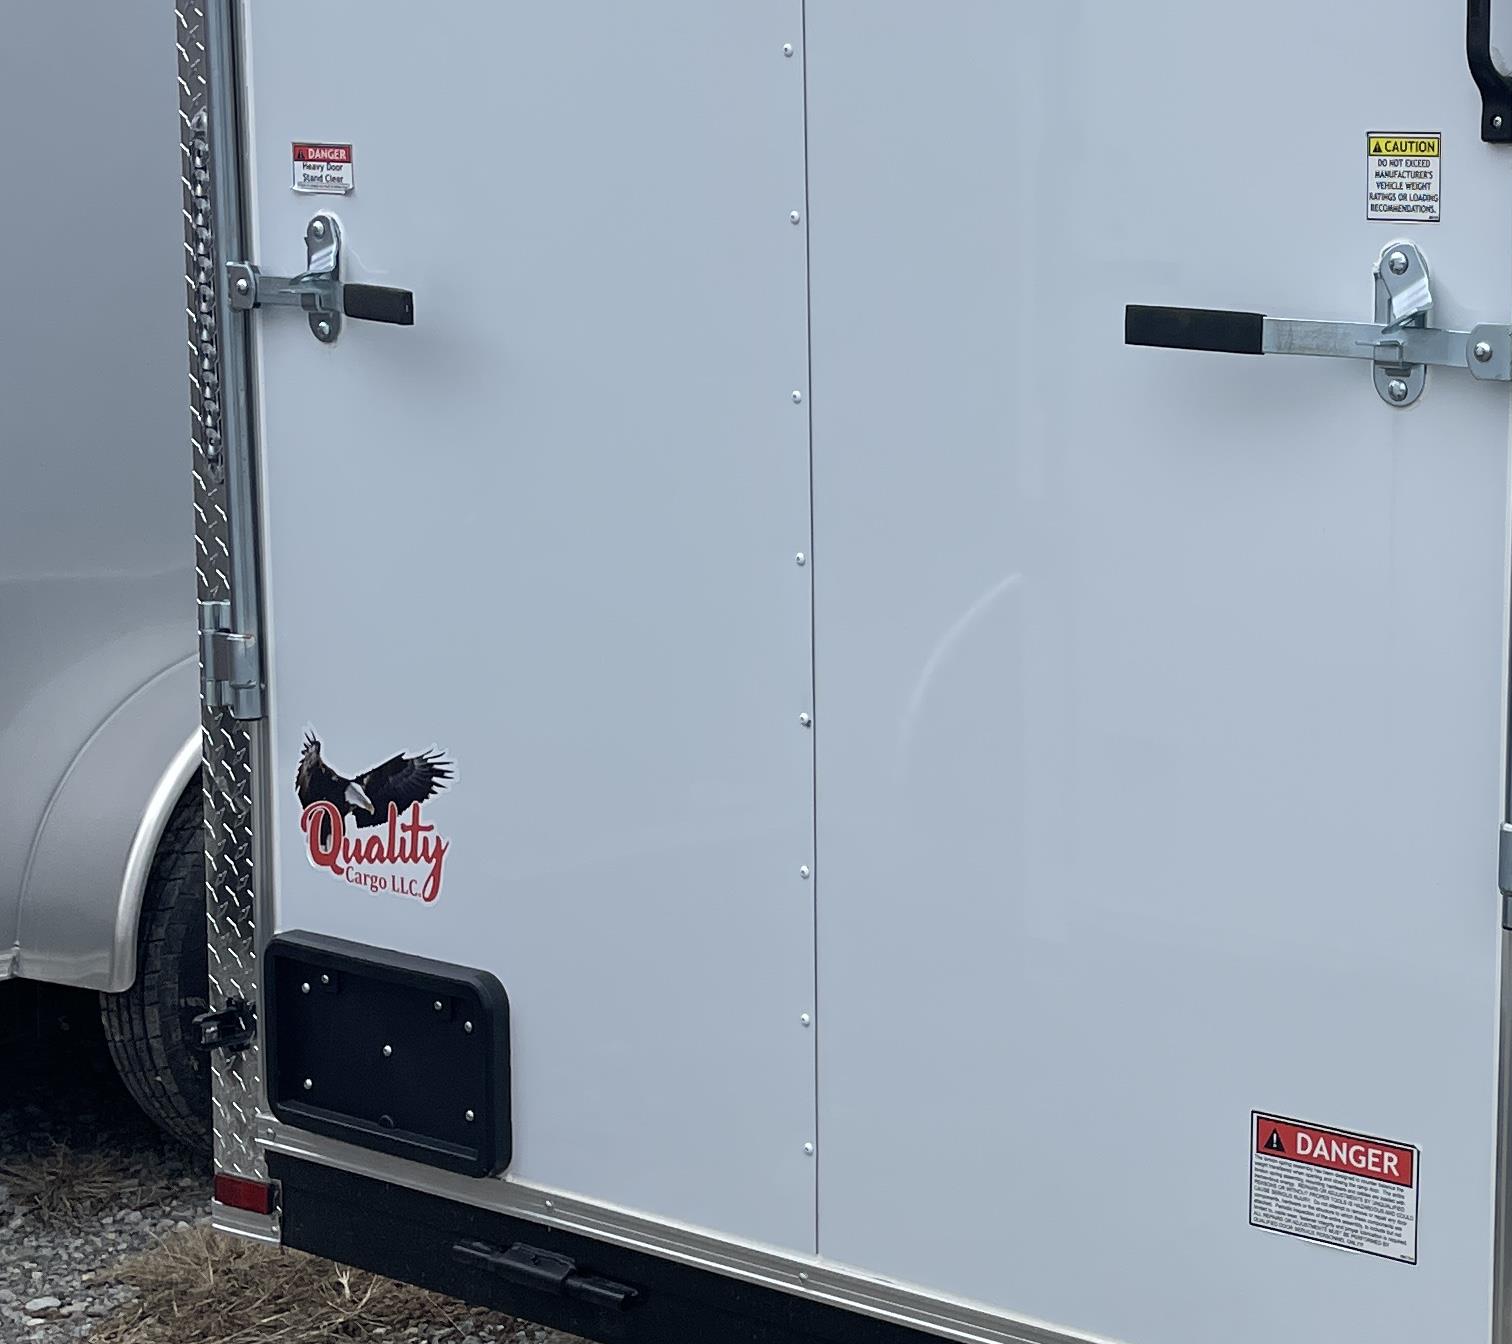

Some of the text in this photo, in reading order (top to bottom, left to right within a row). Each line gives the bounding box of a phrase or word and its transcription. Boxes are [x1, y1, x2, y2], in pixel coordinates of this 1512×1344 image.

[1384, 141, 1435, 152] CAUTION
[308, 148, 346, 160] DANGER
[303, 162, 343, 172] Heavy Door
[1378, 158, 1430, 168] DO NOT EXCEED
[1374, 170, 1433, 179] MANUFACTURER'S
[1376, 182, 1431, 190] VEHICLE WEIGHT
[1369, 192, 1438, 202] RATINGS OR LOADING
[300, 800, 449, 902] Quality
[346, 865, 387, 893] Cargo
[1296, 1132, 1400, 1177] DANGER
